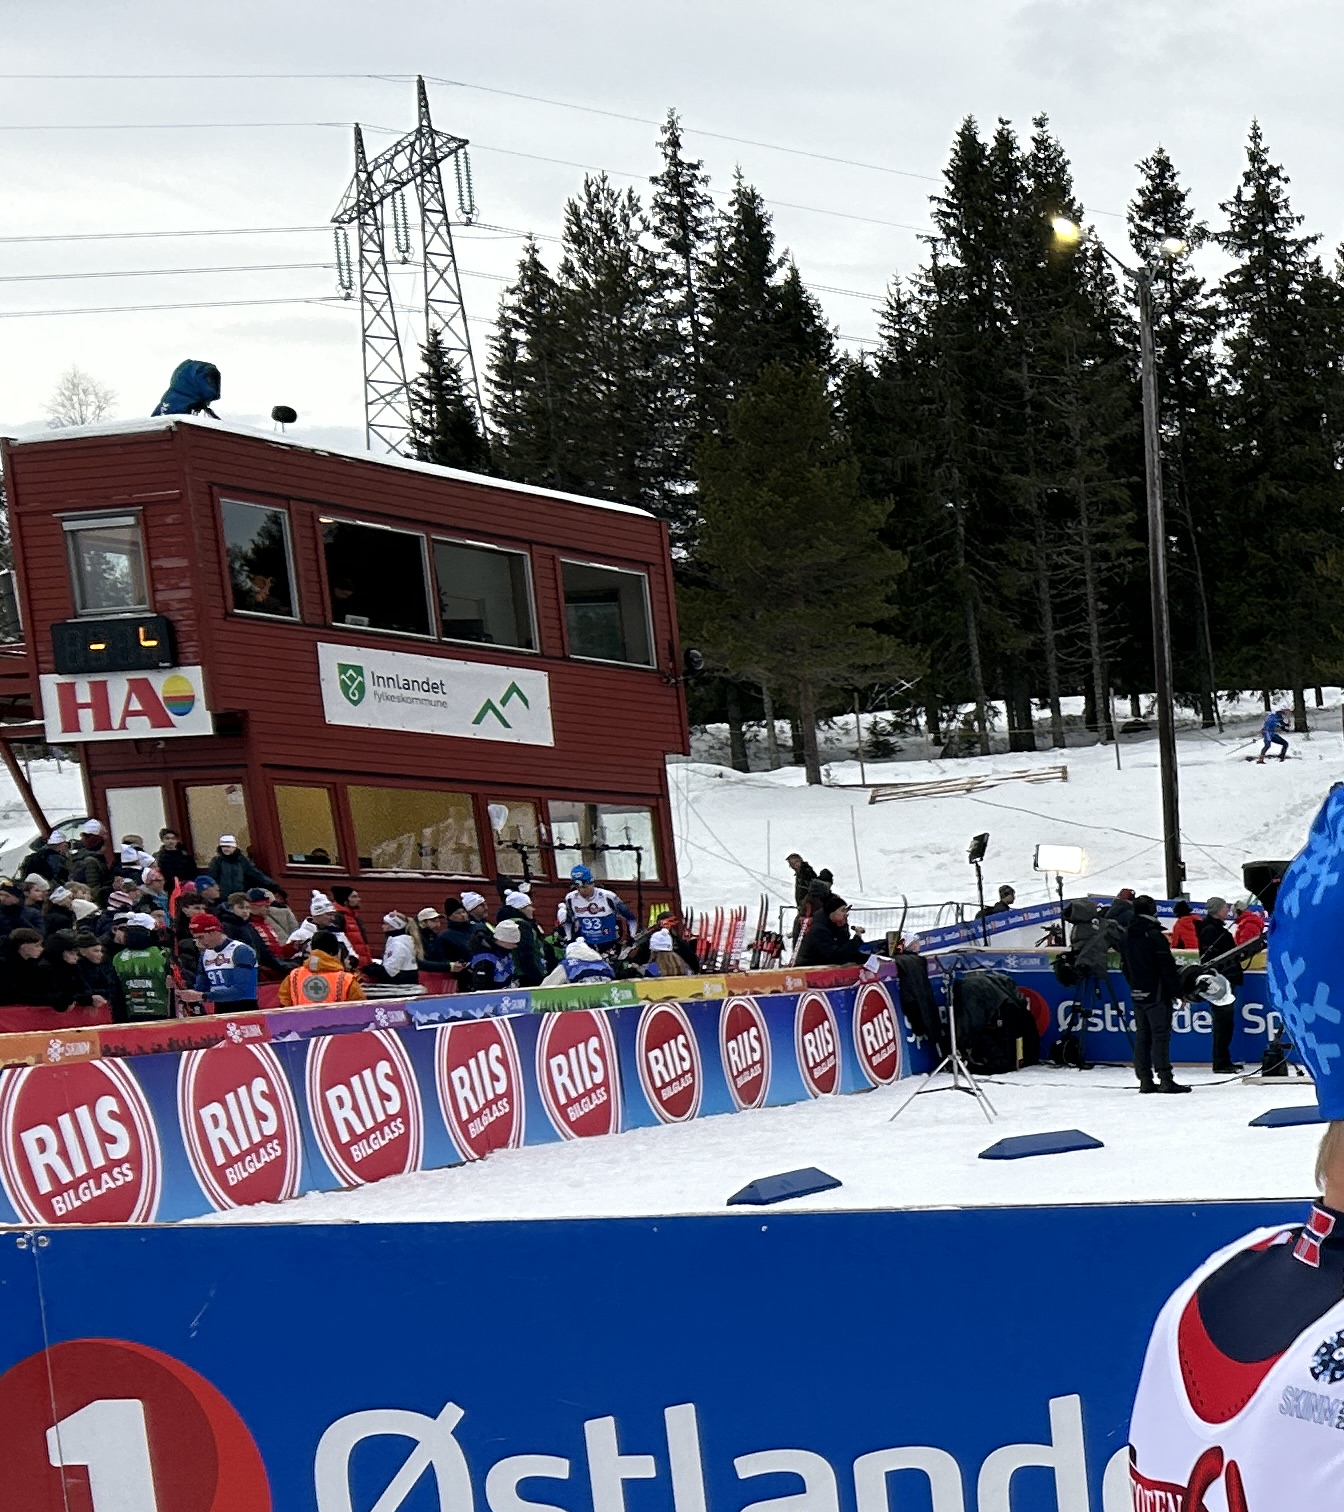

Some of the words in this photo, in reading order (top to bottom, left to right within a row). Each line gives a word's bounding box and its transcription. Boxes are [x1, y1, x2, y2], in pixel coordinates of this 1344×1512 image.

[54, 677, 177, 733] HA
[370, 670, 448, 695] Innlandet
[373, 690, 448, 709] fylkeskommune
[582, 917, 603, 931] 93
[207, 969, 226, 986] 91
[726, 1026, 762, 1077] RIIS
[802, 1020, 834, 1068] RIIS
[861, 1007, 897, 1057] RIIS
[450, 1043, 508, 1122] RIIS
[548, 1035, 604, 1106] RIIS
[646, 1033, 692, 1089] RIIS
[325, 1059, 402, 1145] RIIS
[567, 1086, 608, 1124] BILGLASS
[660, 1072, 694, 1101] BILGLASS
[199, 1076, 279, 1167] RIIS
[349, 1117, 406, 1164] BILGLASS
[467, 1097, 510, 1140] BILGLASS
[19, 1094, 132, 1196] RIIS
[225, 1139, 283, 1187] BILGLASS
[50, 1162, 134, 1218] BILGLASS
